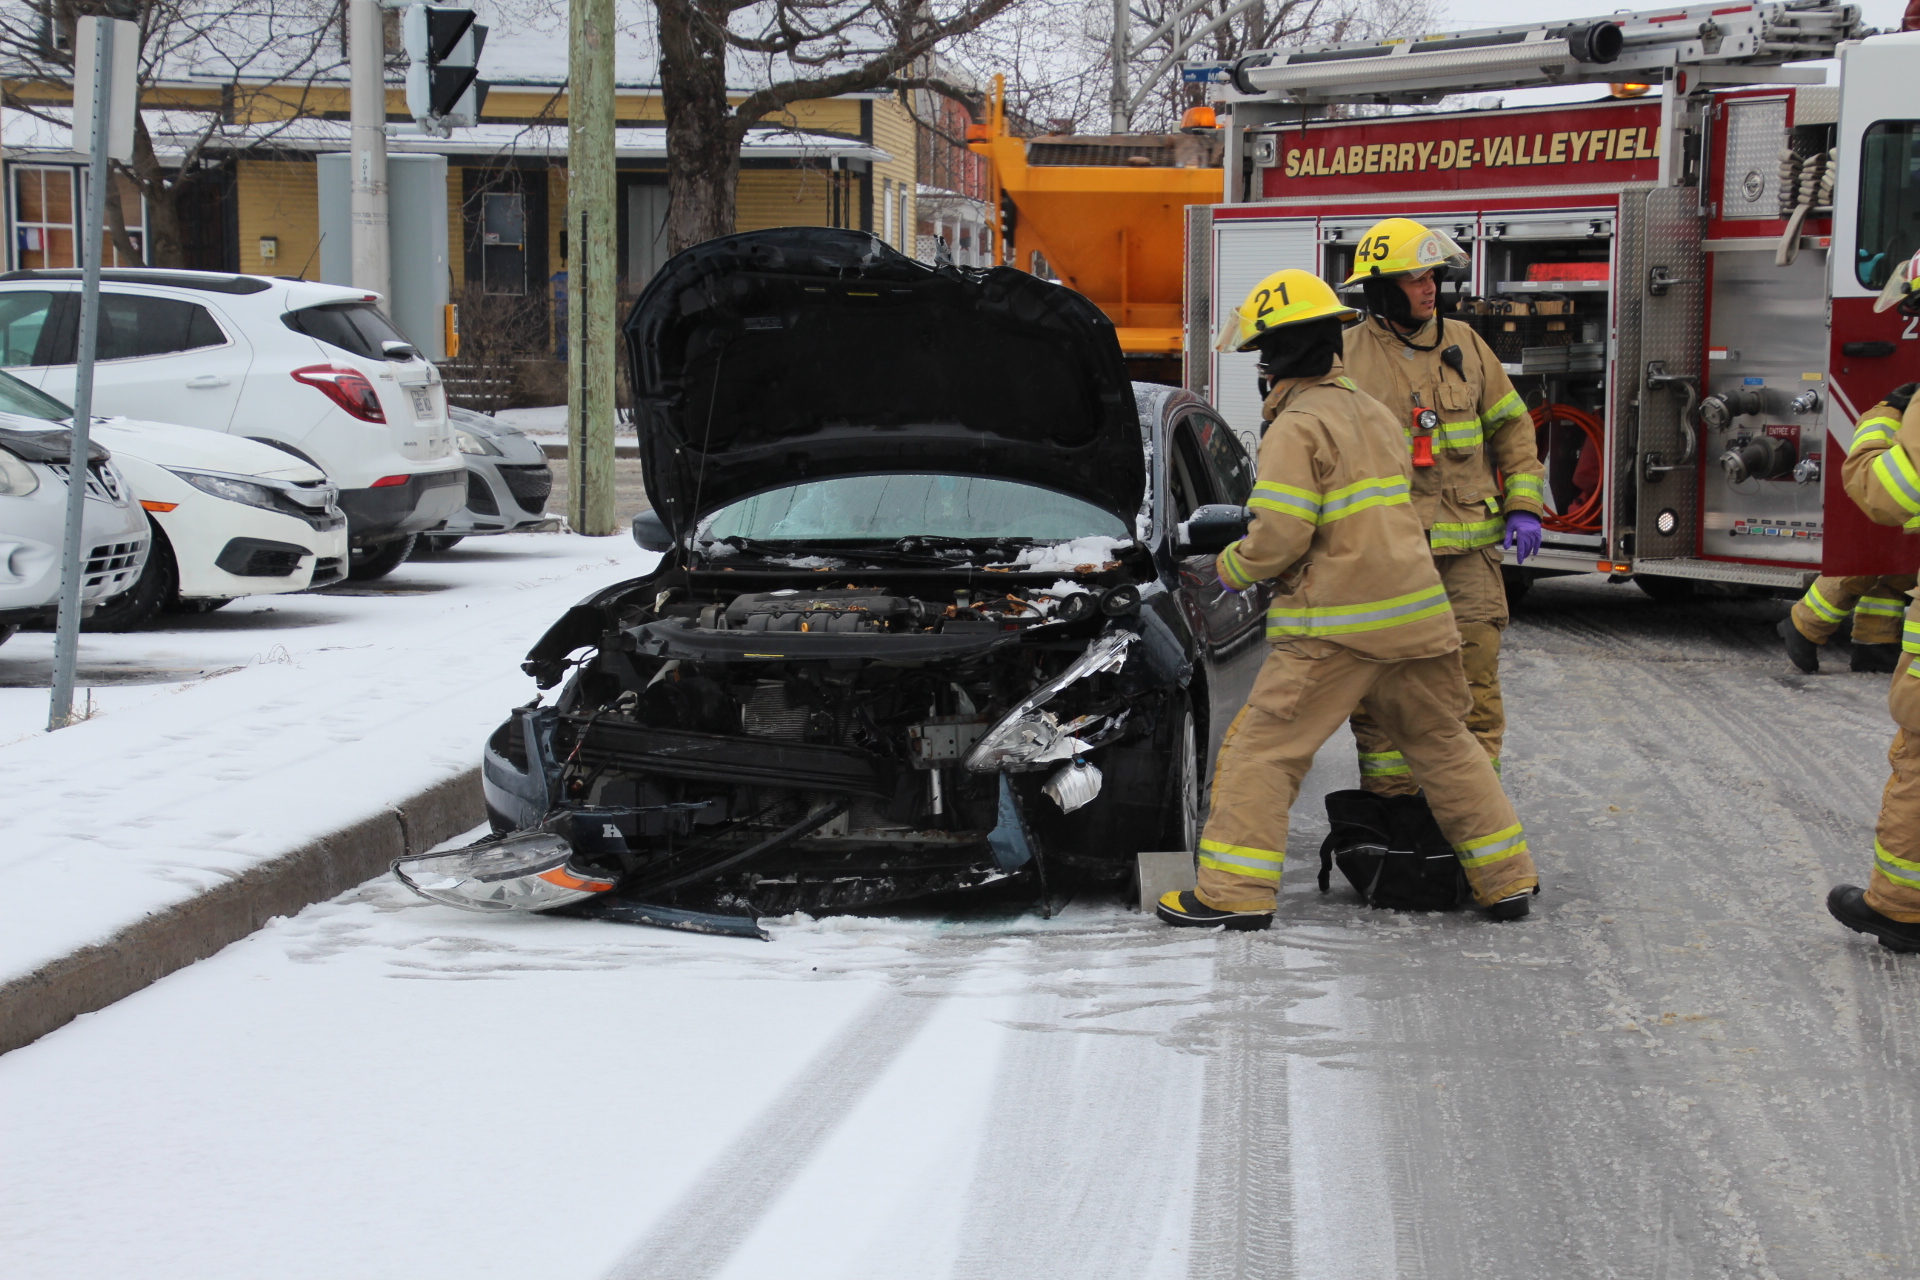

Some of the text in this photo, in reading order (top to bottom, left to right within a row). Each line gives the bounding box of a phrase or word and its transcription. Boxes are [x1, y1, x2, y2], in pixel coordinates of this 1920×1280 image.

[1358, 235, 1390, 262] 45
[1254, 281, 1290, 318] 21
[1768, 426, 1789, 436] ENTRÉE
